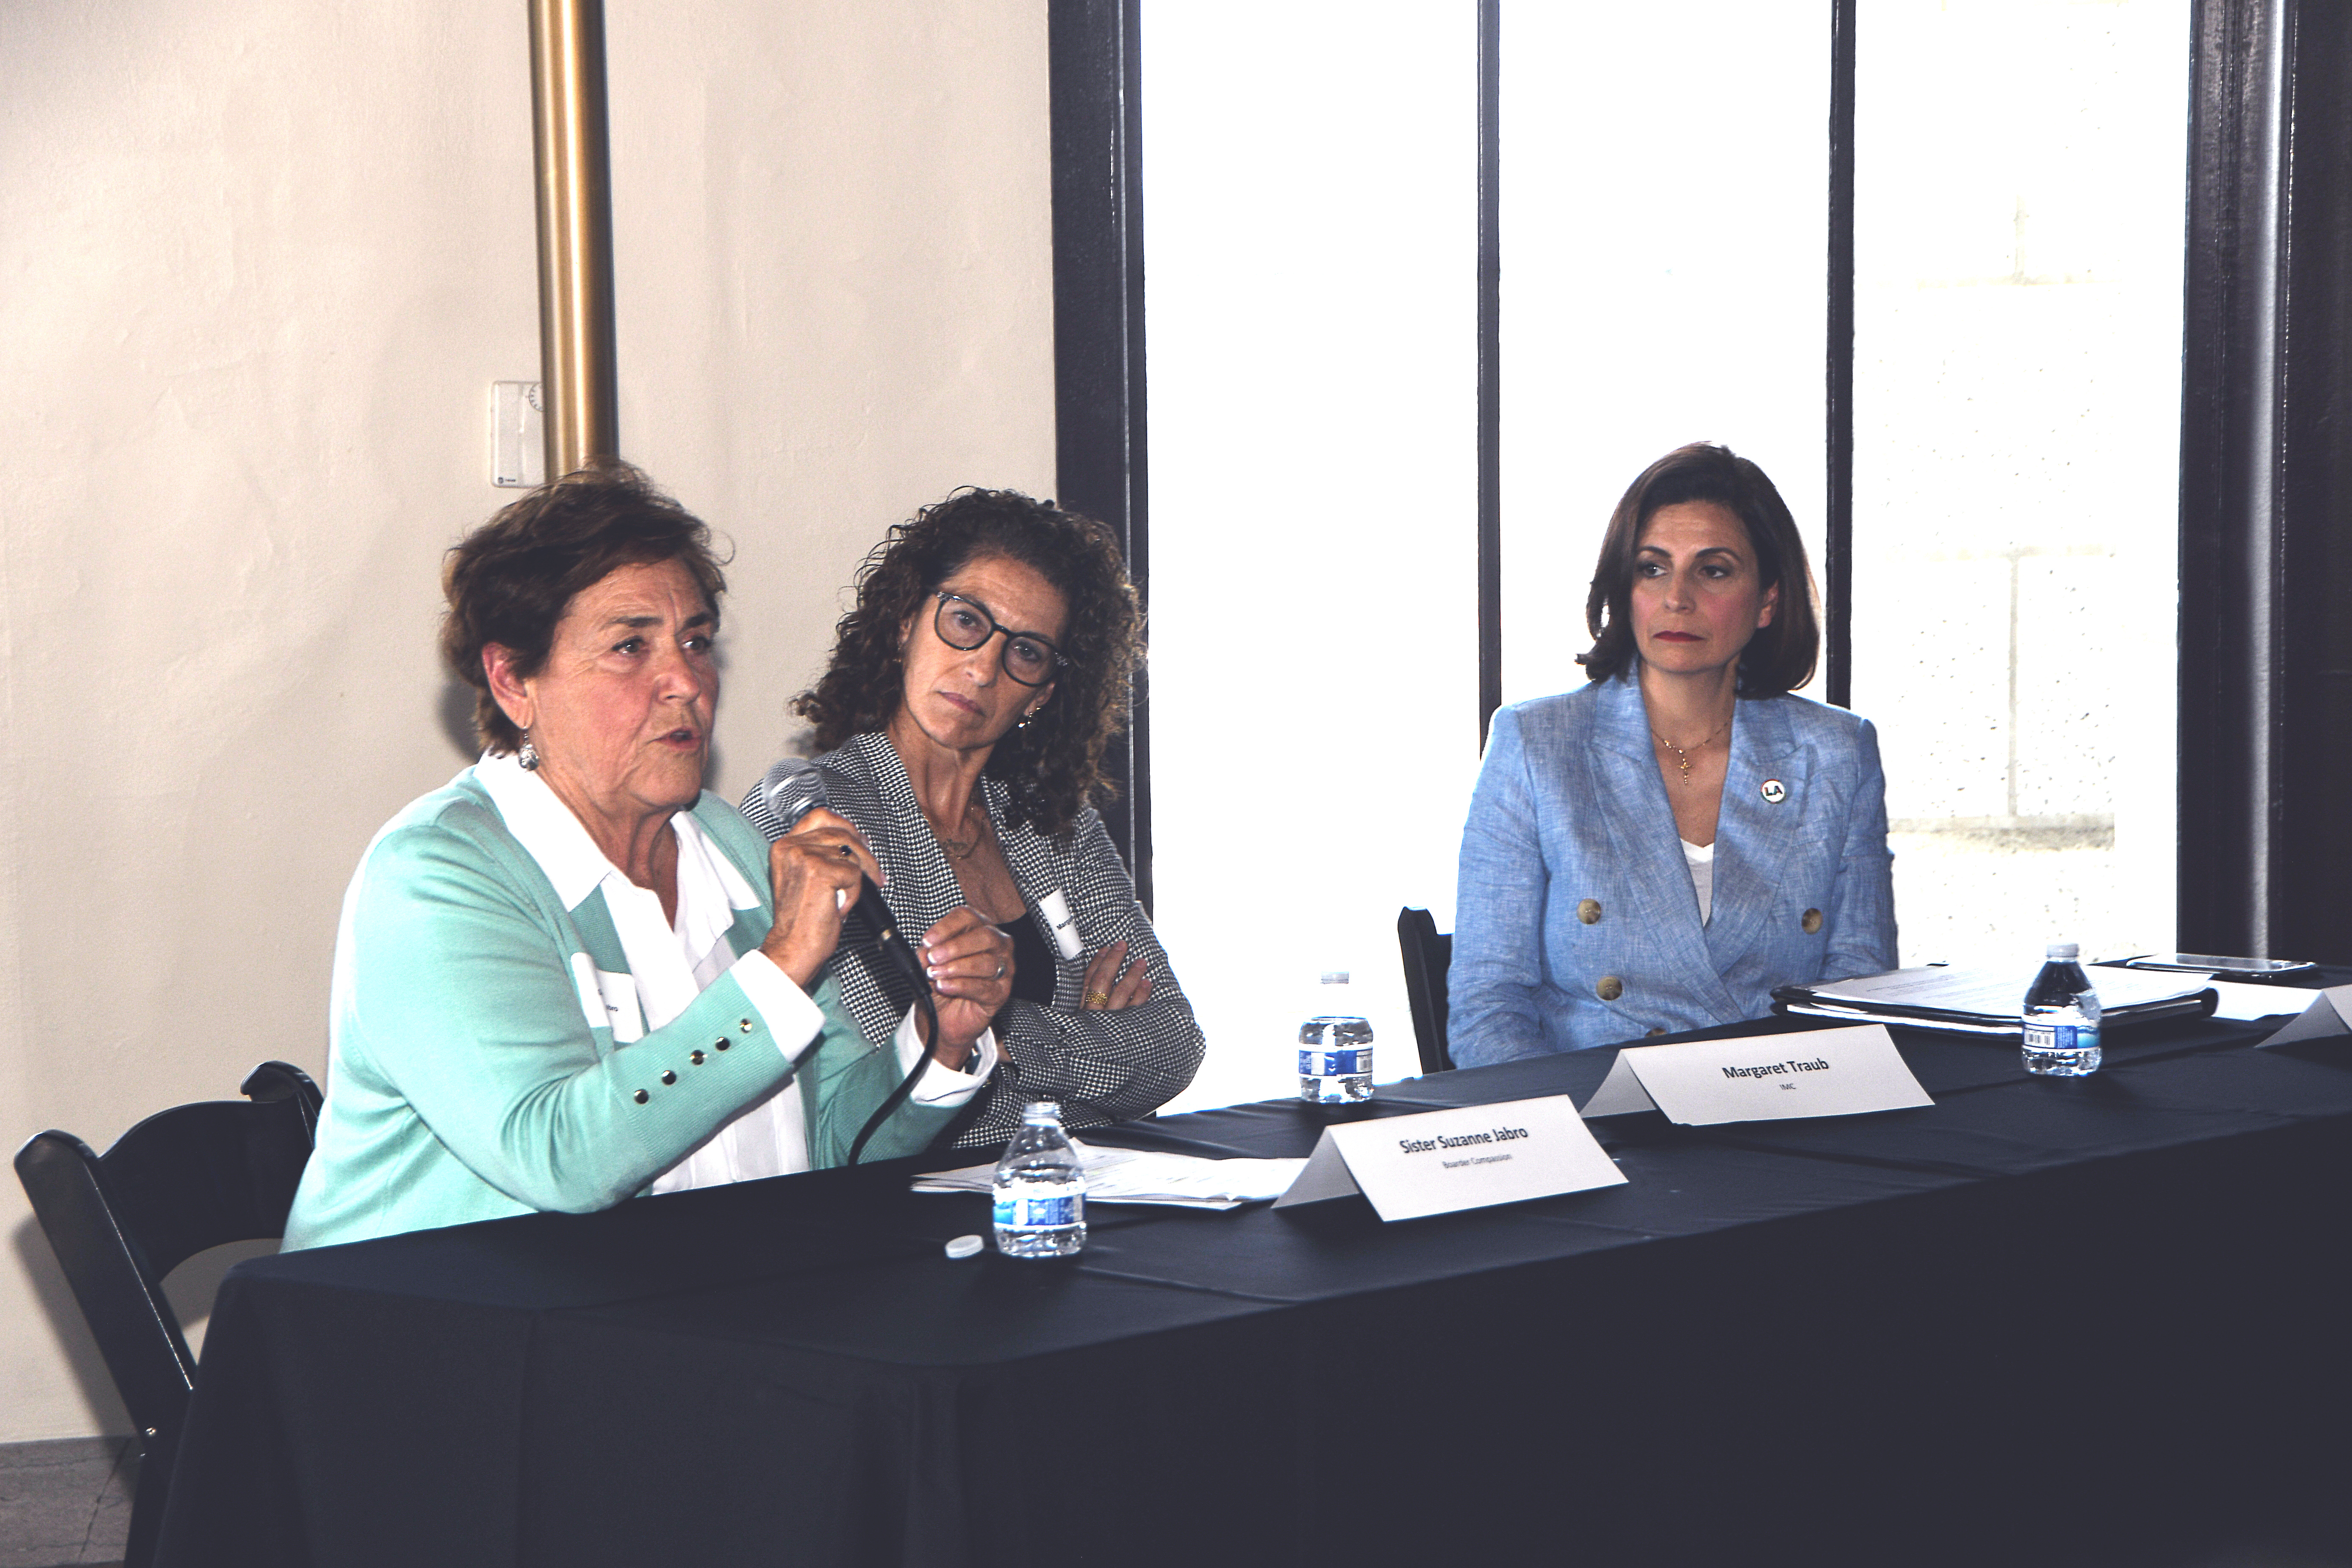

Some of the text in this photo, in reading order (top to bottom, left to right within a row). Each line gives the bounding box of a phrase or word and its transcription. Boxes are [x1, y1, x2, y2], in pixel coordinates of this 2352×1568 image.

[1764, 785, 1783, 796] LA
[1722, 1058, 1829, 1078] Margaret Traub
[1399, 1127, 1529, 1154] Sister Suzanne Jabro
[1470, 1154, 1512, 1164] Compassion
